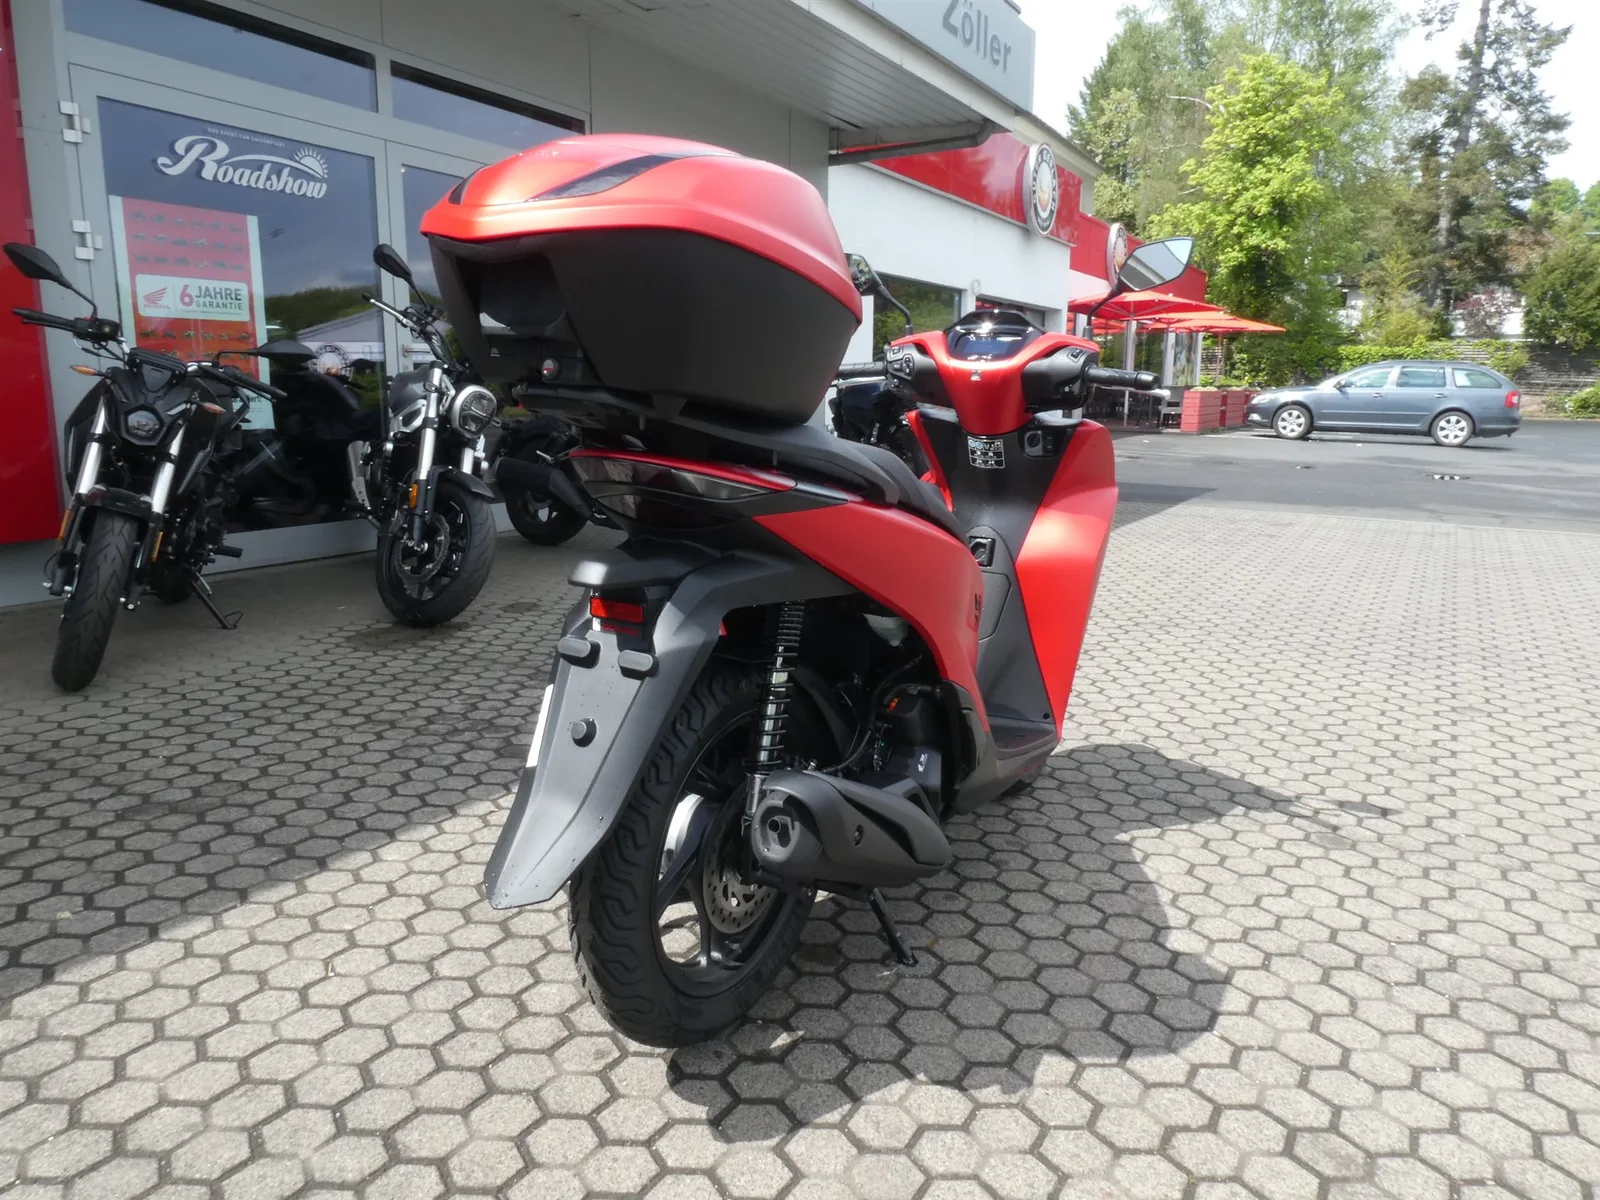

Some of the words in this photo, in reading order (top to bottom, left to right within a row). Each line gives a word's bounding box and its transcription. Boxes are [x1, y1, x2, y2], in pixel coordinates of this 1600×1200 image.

[942, 0, 1011, 73] Zöller
[157, 135, 327, 199] Roadshow
[180, 284, 194, 307] 6
[195, 285, 243, 301] JAHRE
[195, 300, 243, 311] GARANTIE
